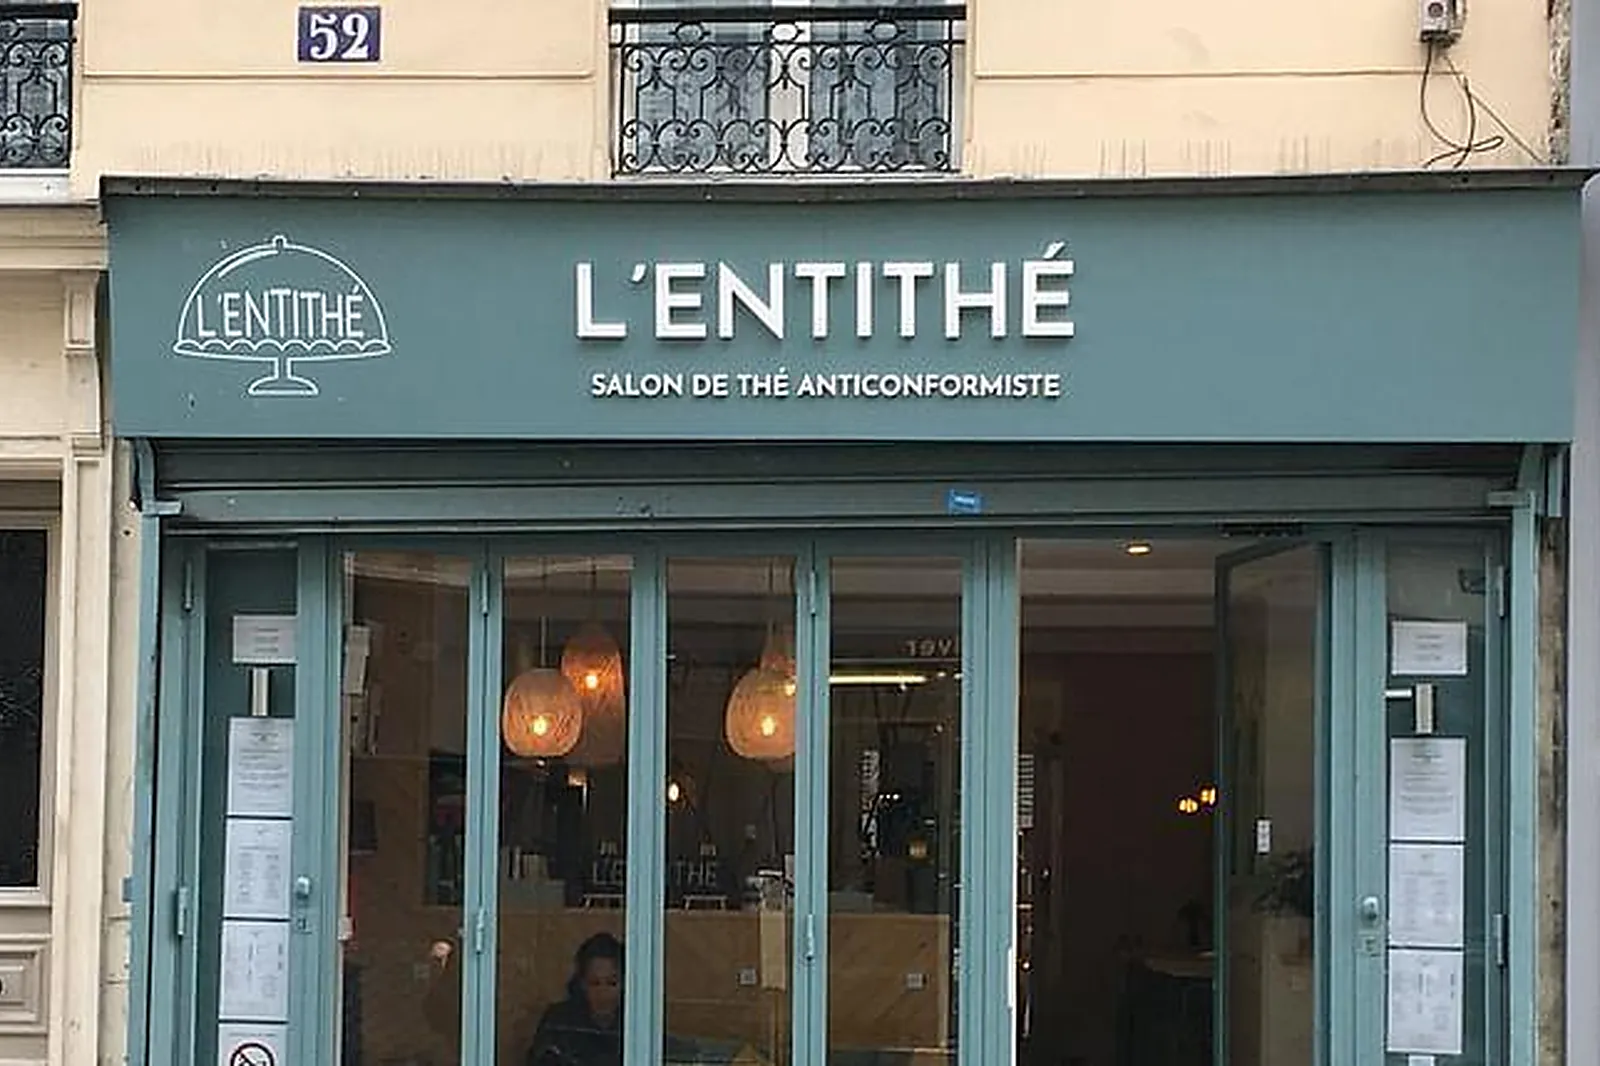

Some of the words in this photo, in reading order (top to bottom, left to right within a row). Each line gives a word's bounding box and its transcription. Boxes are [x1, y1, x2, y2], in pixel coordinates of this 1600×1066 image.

[310, 13, 369, 59] 52
[197, 285, 364, 339] L'ENTITHÉ
[575, 242, 1075, 339] L'ENTITHÉ
[592, 372, 684, 397] SALON
[692, 373, 729, 396] DE
[736, 367, 790, 396] THÉ
[797, 373, 1061, 398] ANTICONFORMISTE
